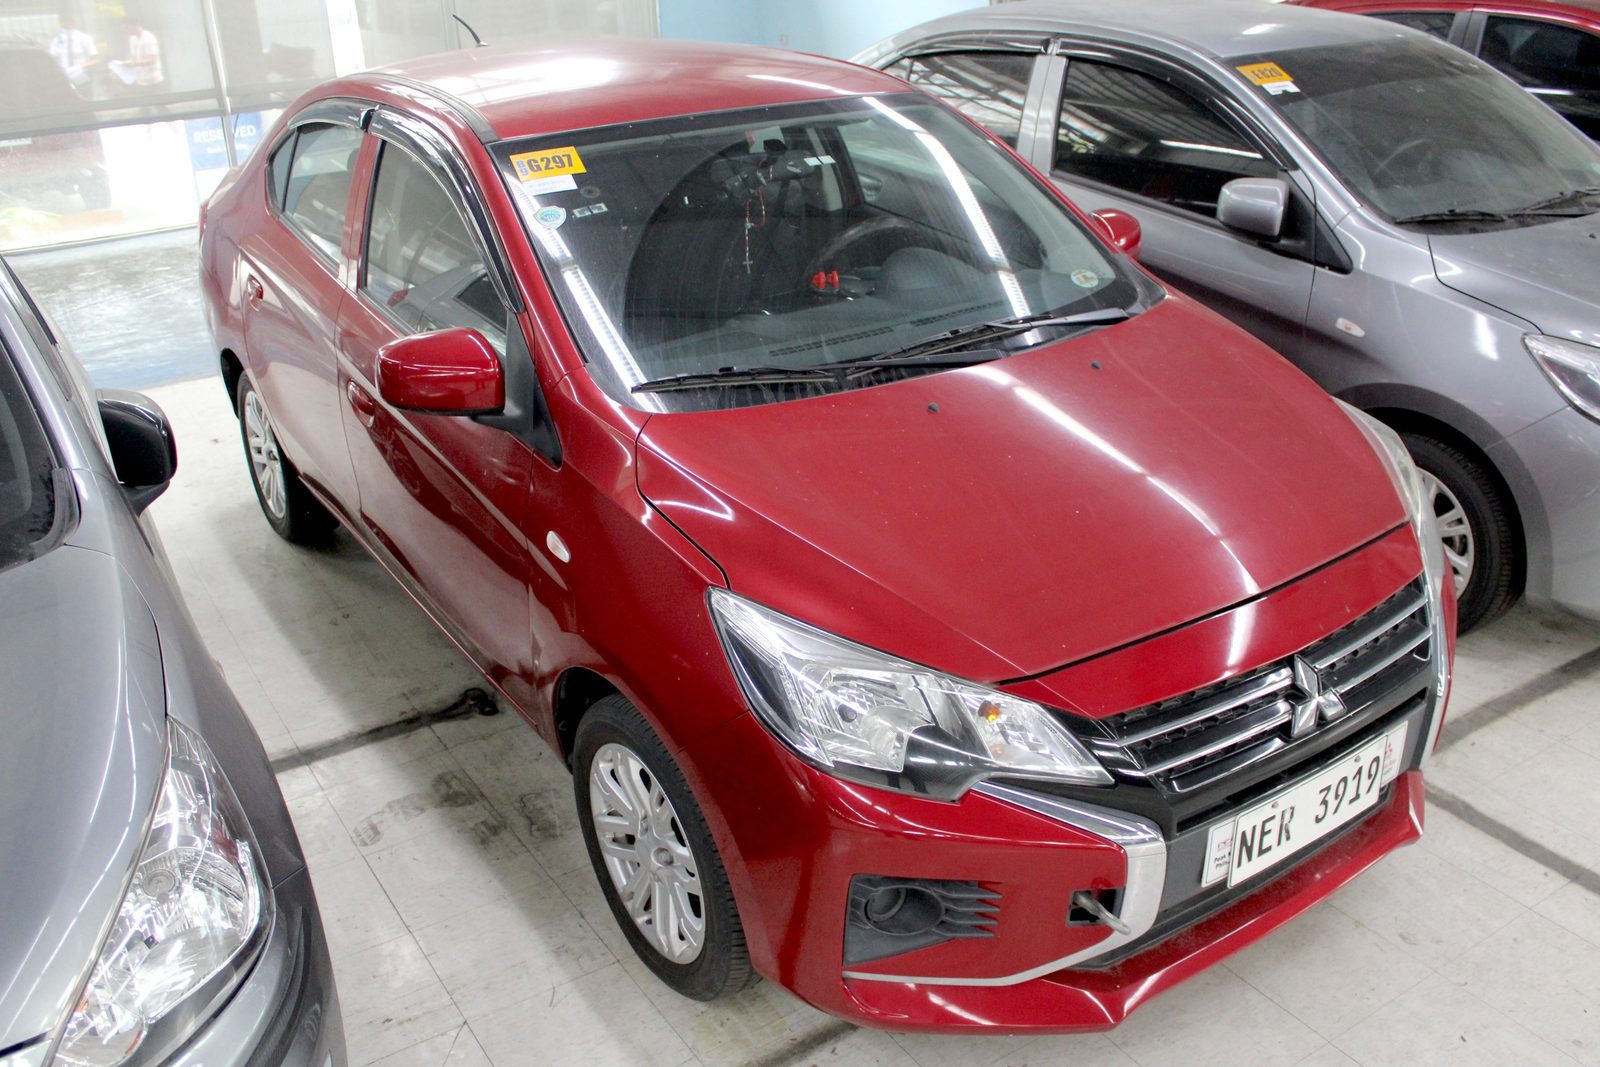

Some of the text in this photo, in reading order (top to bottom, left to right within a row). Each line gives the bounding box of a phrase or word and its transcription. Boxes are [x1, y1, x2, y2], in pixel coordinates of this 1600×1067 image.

[193, 125, 256, 142] RESEVED
[526, 153, 573, 173] G297
[1237, 755, 1380, 868] NER 3919
